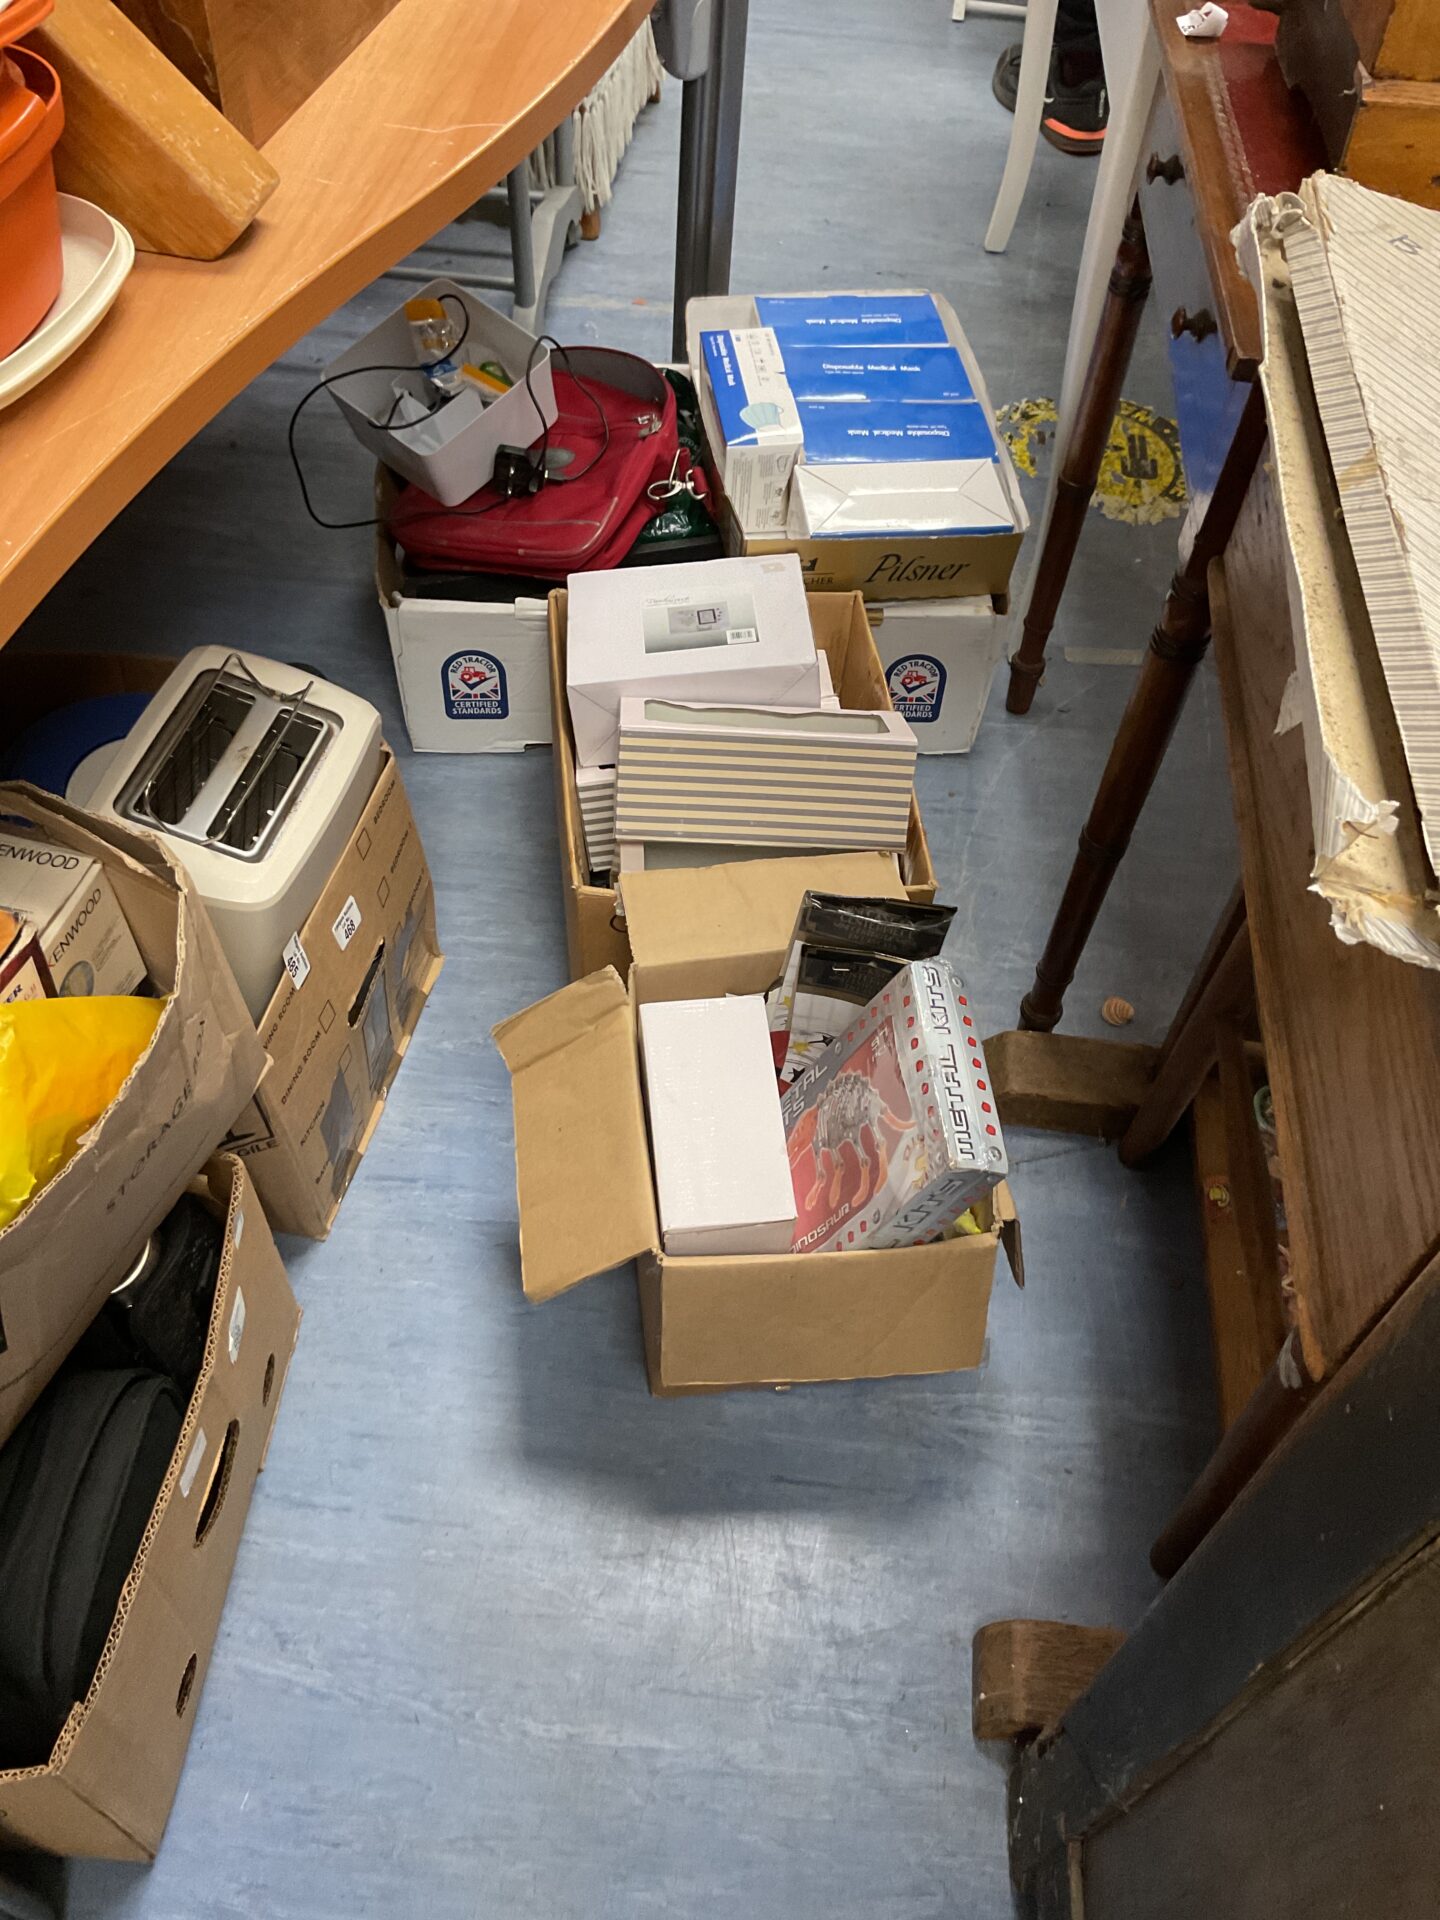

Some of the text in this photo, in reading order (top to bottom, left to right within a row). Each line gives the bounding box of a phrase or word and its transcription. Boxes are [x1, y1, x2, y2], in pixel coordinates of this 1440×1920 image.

[847, 429, 869, 437] Mask
[907, 429, 950, 437] Disposable
[864, 553, 972, 583] Pilsner
[803, 576, 834, 585] CHER
[450, 656, 497, 674] RED TRACTOR
[894, 660, 938, 678] RED TRACTOR
[452, 707, 502, 715] STANDARDS
[894, 704, 932, 712] ERTIFIED
[0, 843, 80, 870] ENWOOD
[344, 919, 356, 940] 468
[287, 956, 299, 978] 485
[263, 986, 297, 1050] VING ROOM
[281, 1031, 322, 1105] DINING ROOM
[923, 965, 976, 1160] METAL KITS
[781, 1064, 828, 1112] ETAL
[783, 1095, 805, 1125] TS
[301, 1100, 325, 1147] KITCHEN
[106, 1078, 192, 1211] STORAGE
[237, 1138, 280, 1158] GILE
